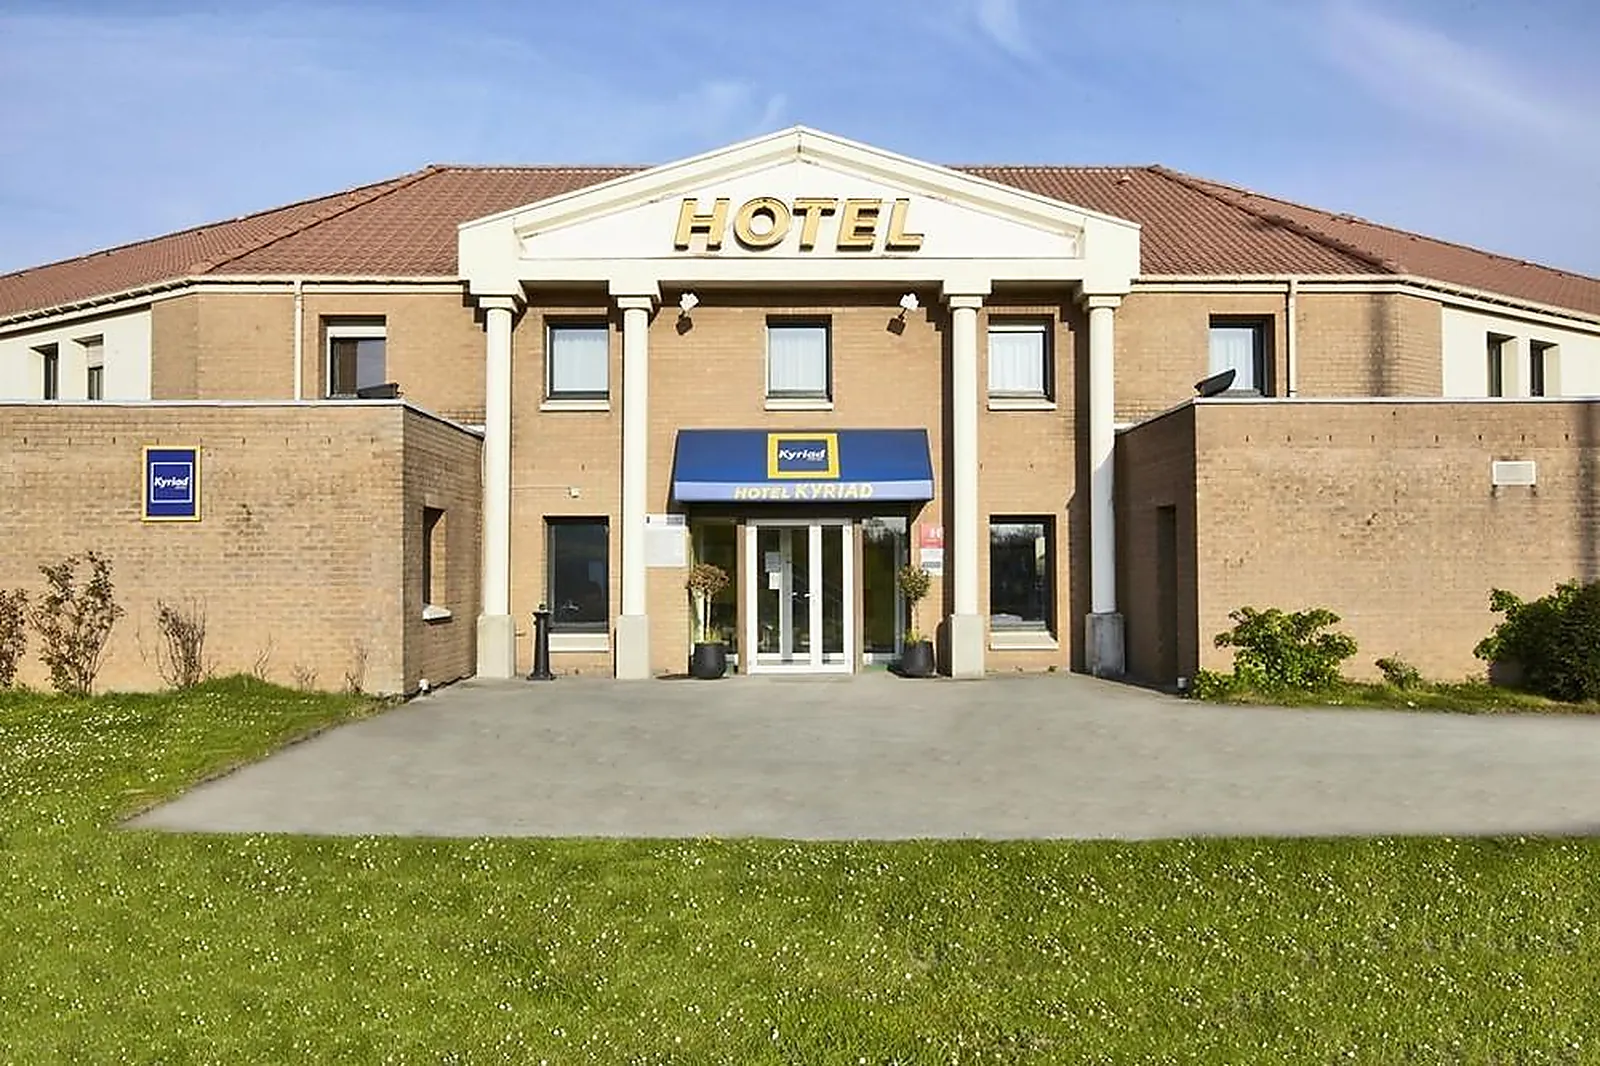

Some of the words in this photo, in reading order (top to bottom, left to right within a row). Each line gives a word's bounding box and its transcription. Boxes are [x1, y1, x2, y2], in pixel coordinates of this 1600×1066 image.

[674, 197, 924, 251] HOTEL
[779, 449, 825, 460] Kyriad
[154, 476, 189, 488] Kyriad
[734, 486, 791, 499] HOTEL
[795, 482, 874, 499] KYRIAD
